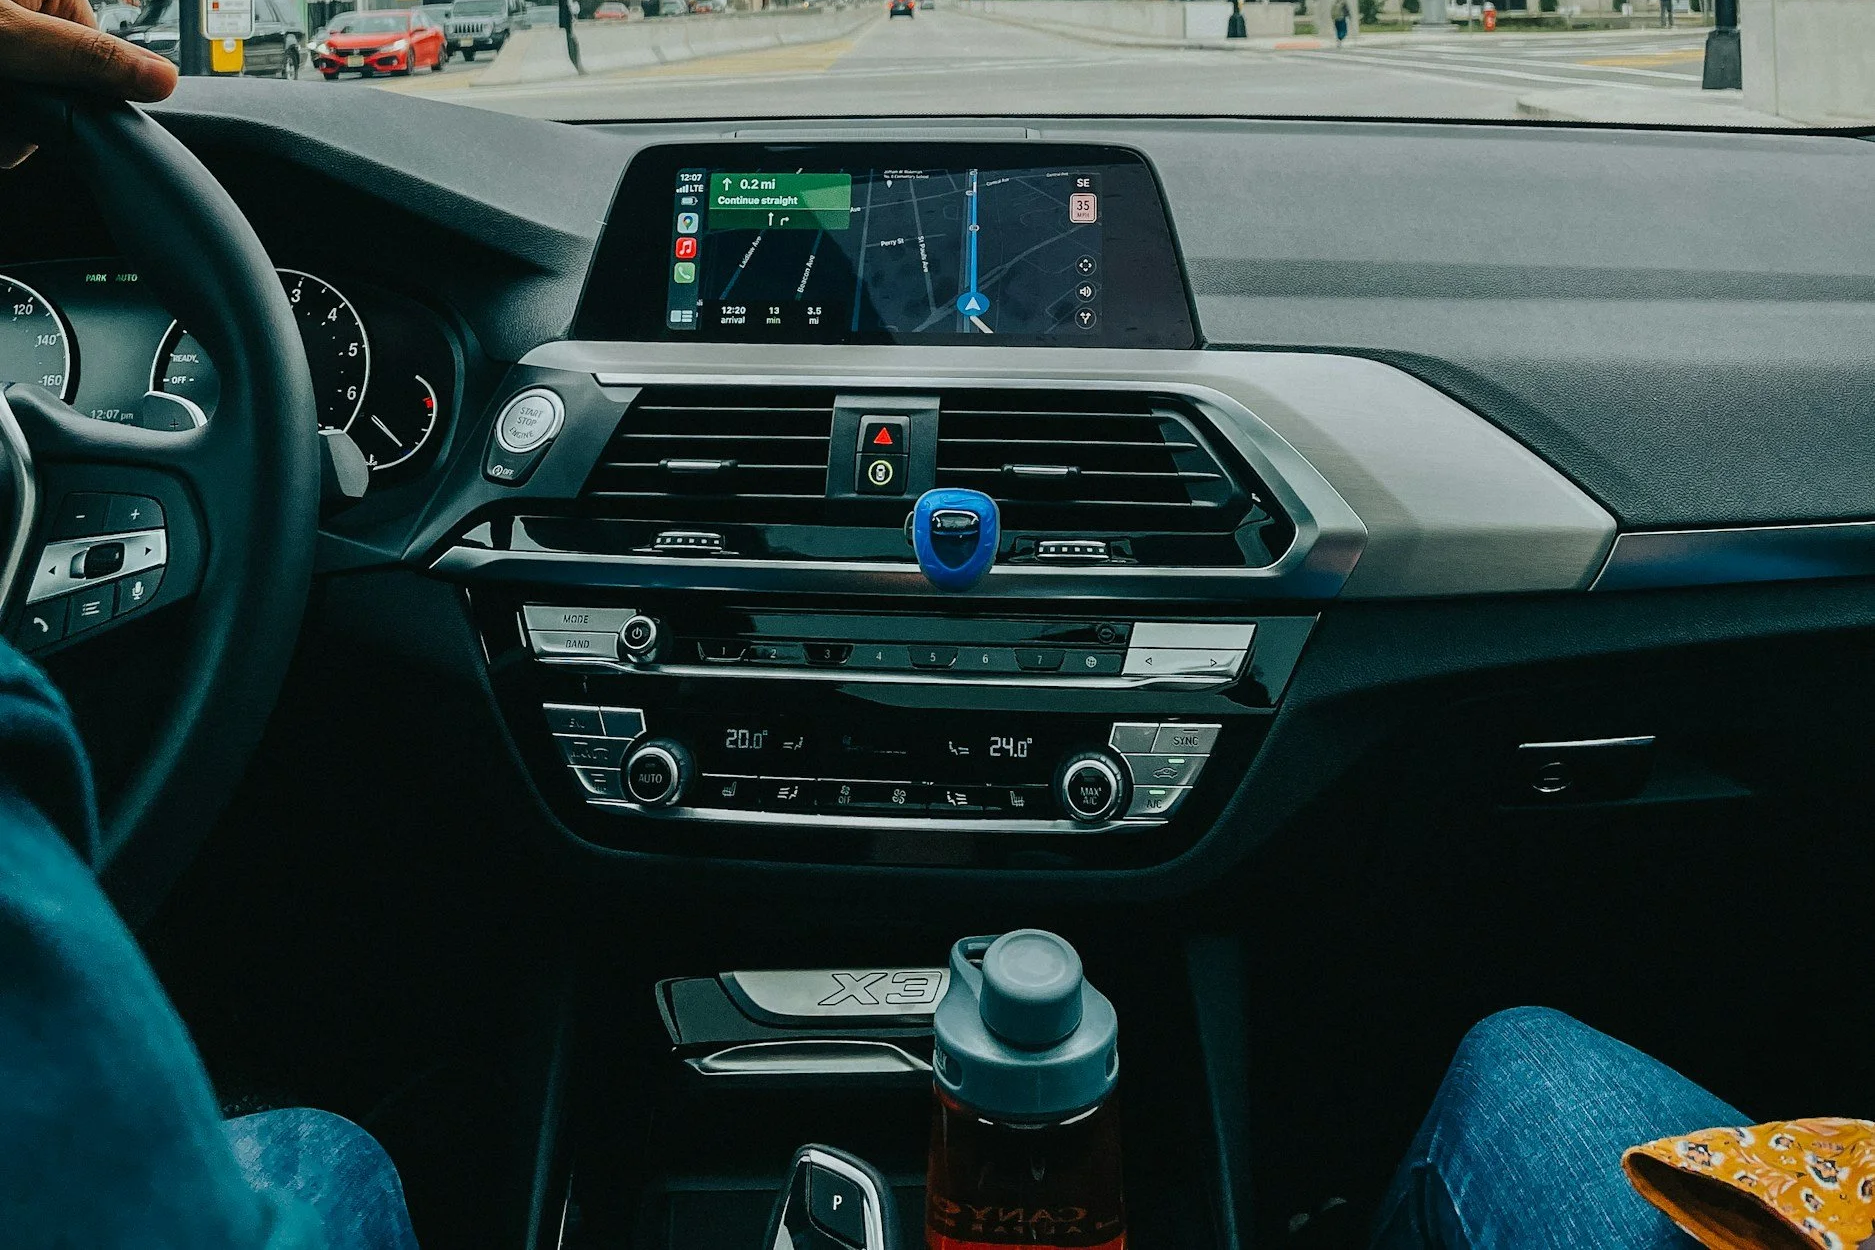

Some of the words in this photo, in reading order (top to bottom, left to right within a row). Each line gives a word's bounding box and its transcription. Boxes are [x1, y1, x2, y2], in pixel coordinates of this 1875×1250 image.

[680, 173, 703, 182] 12:07
[1076, 178, 1090, 188] SE
[689, 185, 704, 193] LTE
[739, 179, 760, 190] 0.2
[760, 178, 776, 190] mi
[717, 195, 760, 205] Continue
[761, 195, 798, 206] straight
[1076, 200, 1090, 211] 35
[751, 235, 762, 248] Ave
[880, 239, 897, 247] Perry
[897, 237, 905, 245] St
[85, 273, 107, 282] PARK
[115, 273, 138, 282] AUTO
[796, 267, 811, 293] Beacon
[805, 254, 816, 268] Ave
[290, 288, 301, 303] 3
[13, 303, 34, 316] 120
[327, 307, 338, 322] 4
[721, 306, 746, 315] 12:20
[768, 307, 780, 315] 13
[807, 307, 822, 315] 3.5
[720, 316, 746, 325] arrival
[766, 316, 781, 324] min
[808, 316, 819, 325] mi
[36, 334, 57, 347] 140
[348, 341, 358, 357] 5
[172, 353, 197, 363] READY
[41, 375, 63, 387] 160
[171, 376, 187, 384] OFF
[346, 386, 357, 401] 6
[90, 409, 120, 420] 12:07
[120, 411, 134, 421] pm
[519, 406, 544, 418] START
[516, 416, 538, 427] STOP
[509, 426, 535, 440] ENGINE
[502, 468, 515, 476] OFF
[562, 614, 589, 625] MODE
[565, 639, 590, 650] BAND
[721, 645, 726, 656] 1
[770, 648, 777, 658] 2
[824, 649, 831, 659] 3
[876, 651, 882, 662] 4
[930, 652, 936, 662] 5
[982, 653, 988, 664] 6
[1037, 654, 1043, 664] 7
[1173, 735, 1199, 746] SYNC
[638, 772, 663, 784] AUTO
[837, 795, 852, 804] OFF
[1082, 795, 1097, 806] A/C
[1146, 799, 1162, 809] A/C
[817, 970, 943, 1006] X3
[832, 1194, 843, 1211] P
